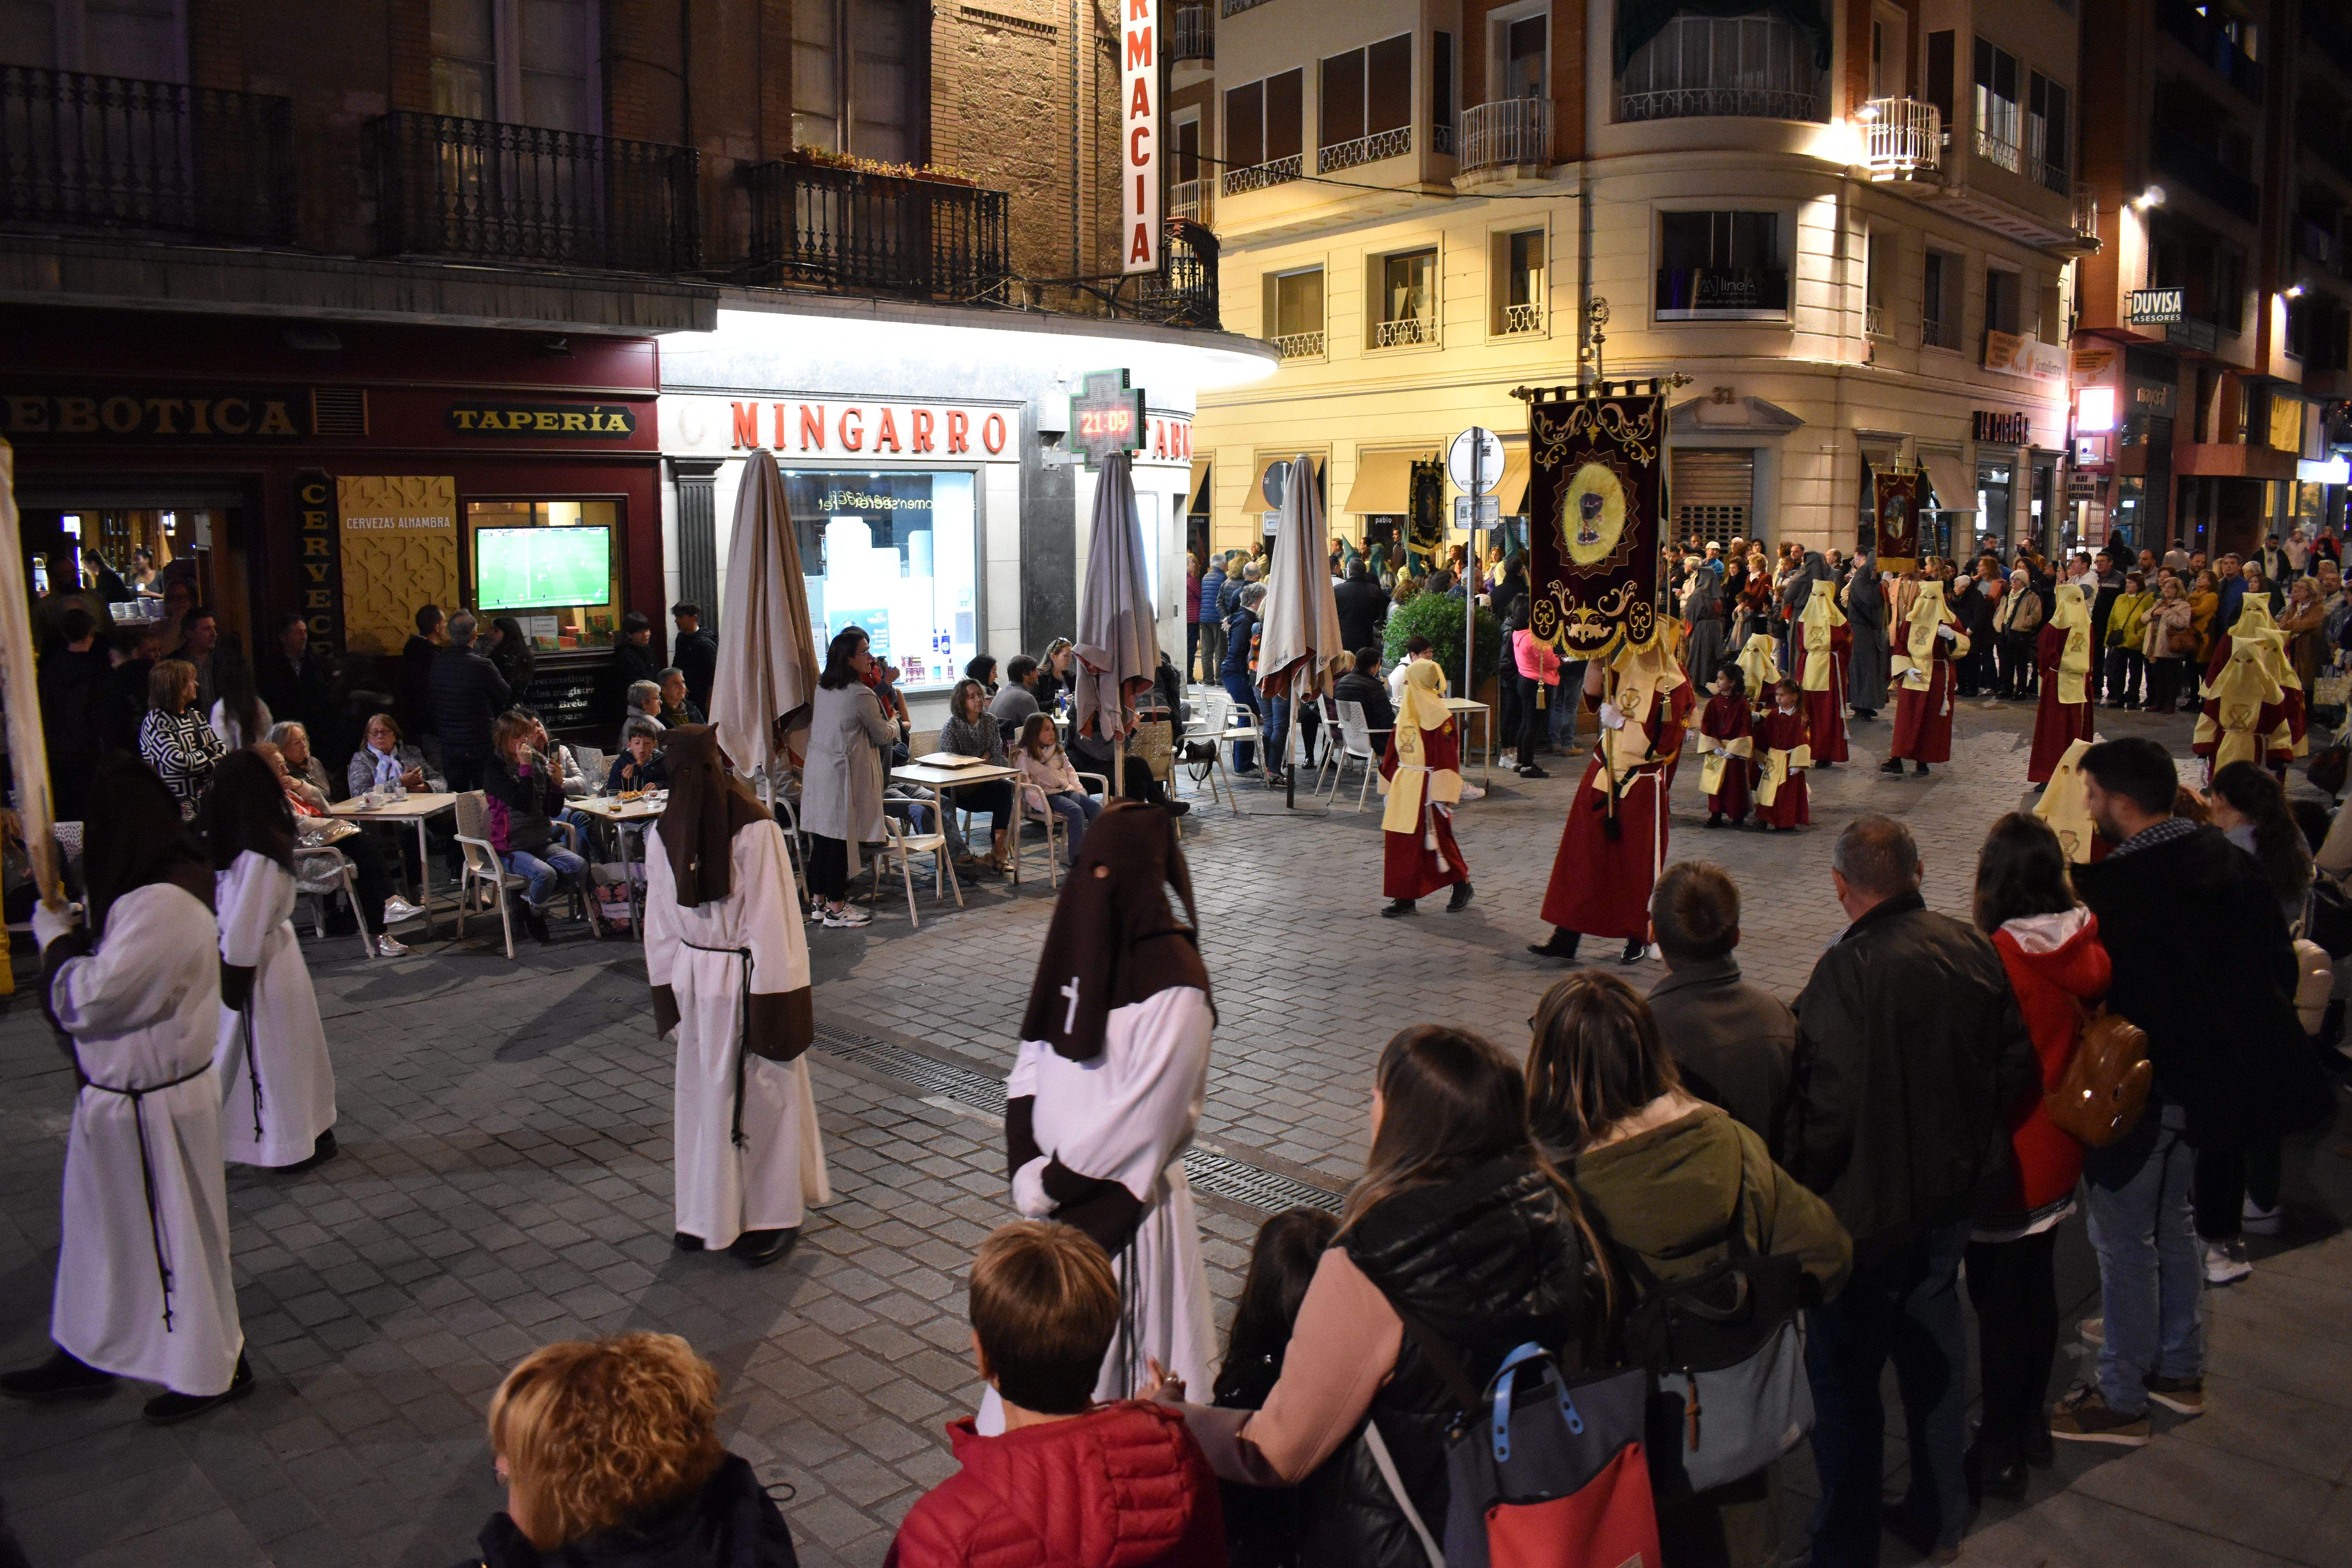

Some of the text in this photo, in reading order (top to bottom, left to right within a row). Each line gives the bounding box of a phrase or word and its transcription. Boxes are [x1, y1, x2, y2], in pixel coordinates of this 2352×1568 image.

[2133, 291, 2181, 314] DUVISA
[453, 407, 630, 431] TAPERÍA
[730, 401, 1006, 453] MINGARRO
[1082, 410, 1129, 433] 21:09
[347, 517, 450, 529] CERVEZAS ALHAMBRA
[1375, 516, 1392, 524] pablo
